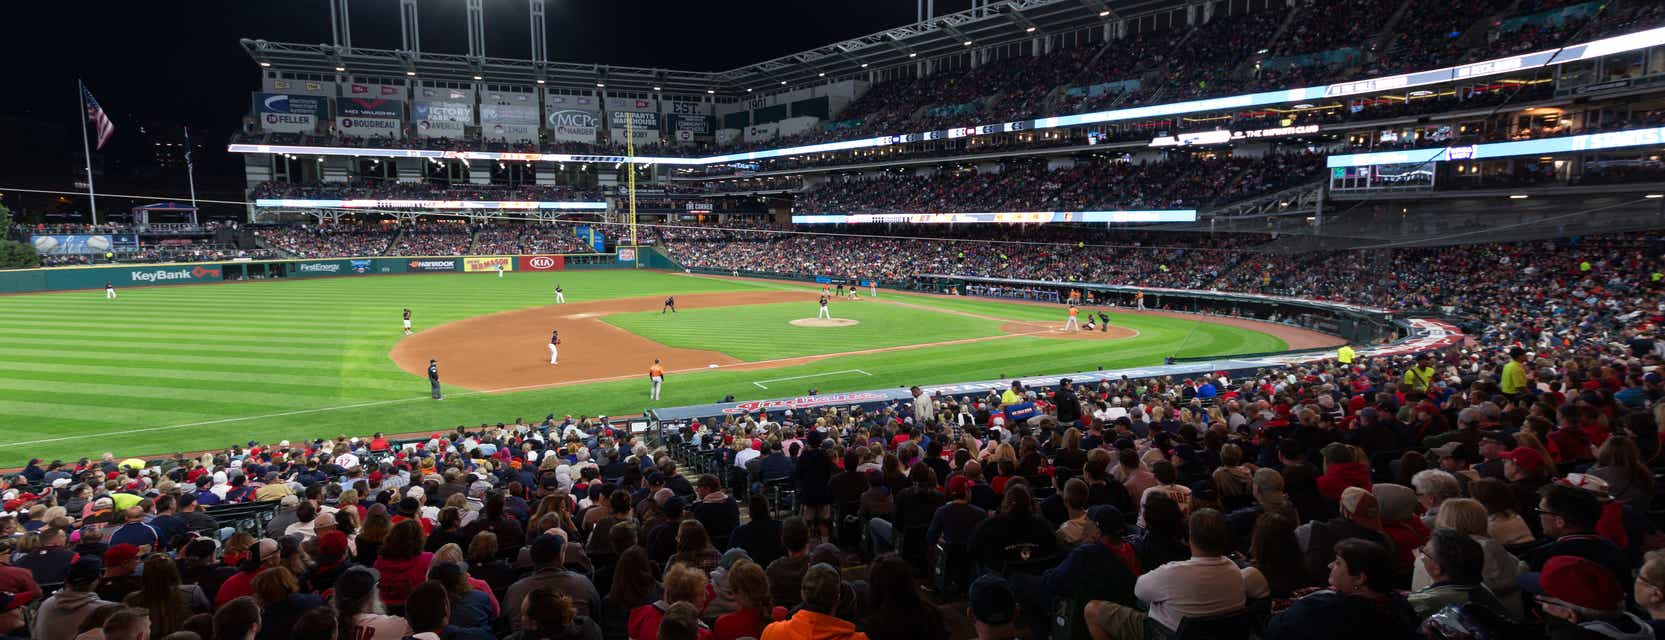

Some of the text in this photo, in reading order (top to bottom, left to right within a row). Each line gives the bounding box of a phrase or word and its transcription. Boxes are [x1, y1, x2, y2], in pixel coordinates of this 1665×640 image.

[673, 102, 700, 114] EST.
[279, 116, 310, 124] FELLER
[353, 120, 395, 128] BOUDREAU
[532, 258, 553, 267] KIA
[131, 270, 191, 283] KeyBank
